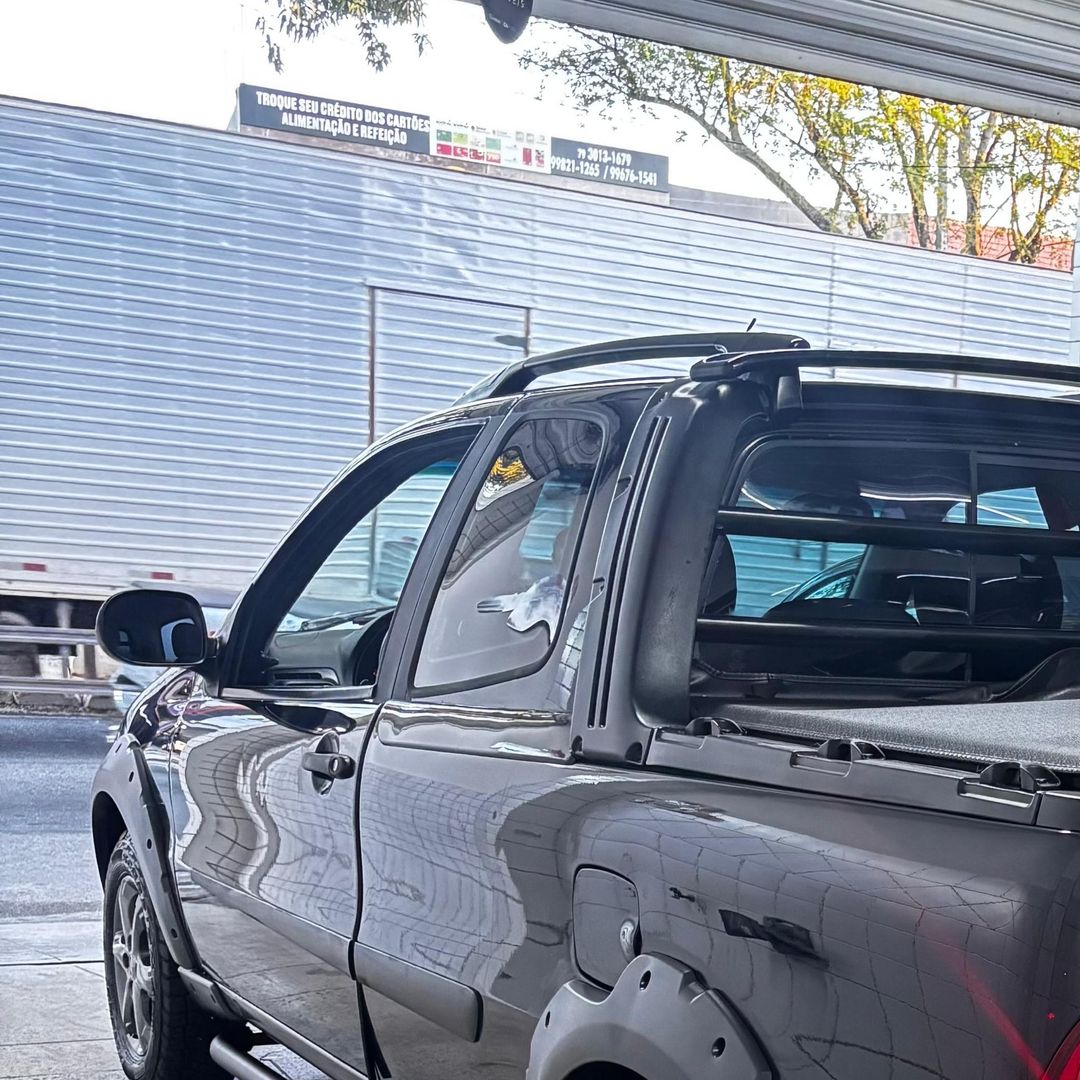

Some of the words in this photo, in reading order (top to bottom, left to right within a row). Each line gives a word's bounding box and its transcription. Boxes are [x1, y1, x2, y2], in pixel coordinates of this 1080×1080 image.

[256, 91, 298, 111] TROQUE
[299, 98, 319, 114] SEU
[320, 101, 363, 121] CRÉDITO
[364, 108, 386, 125] DOS
[386, 112, 430, 132] CARTÕES
[281, 111, 351, 137] ALIMENTAÇÃO
[352, 122, 360, 137] E
[360, 124, 408, 146] REFEIÇÃO
[550, 155, 600, 178] 99821-1265
[609, 165, 658, 187] 99676-1541
[587, 146, 632, 167] 3013-1679
